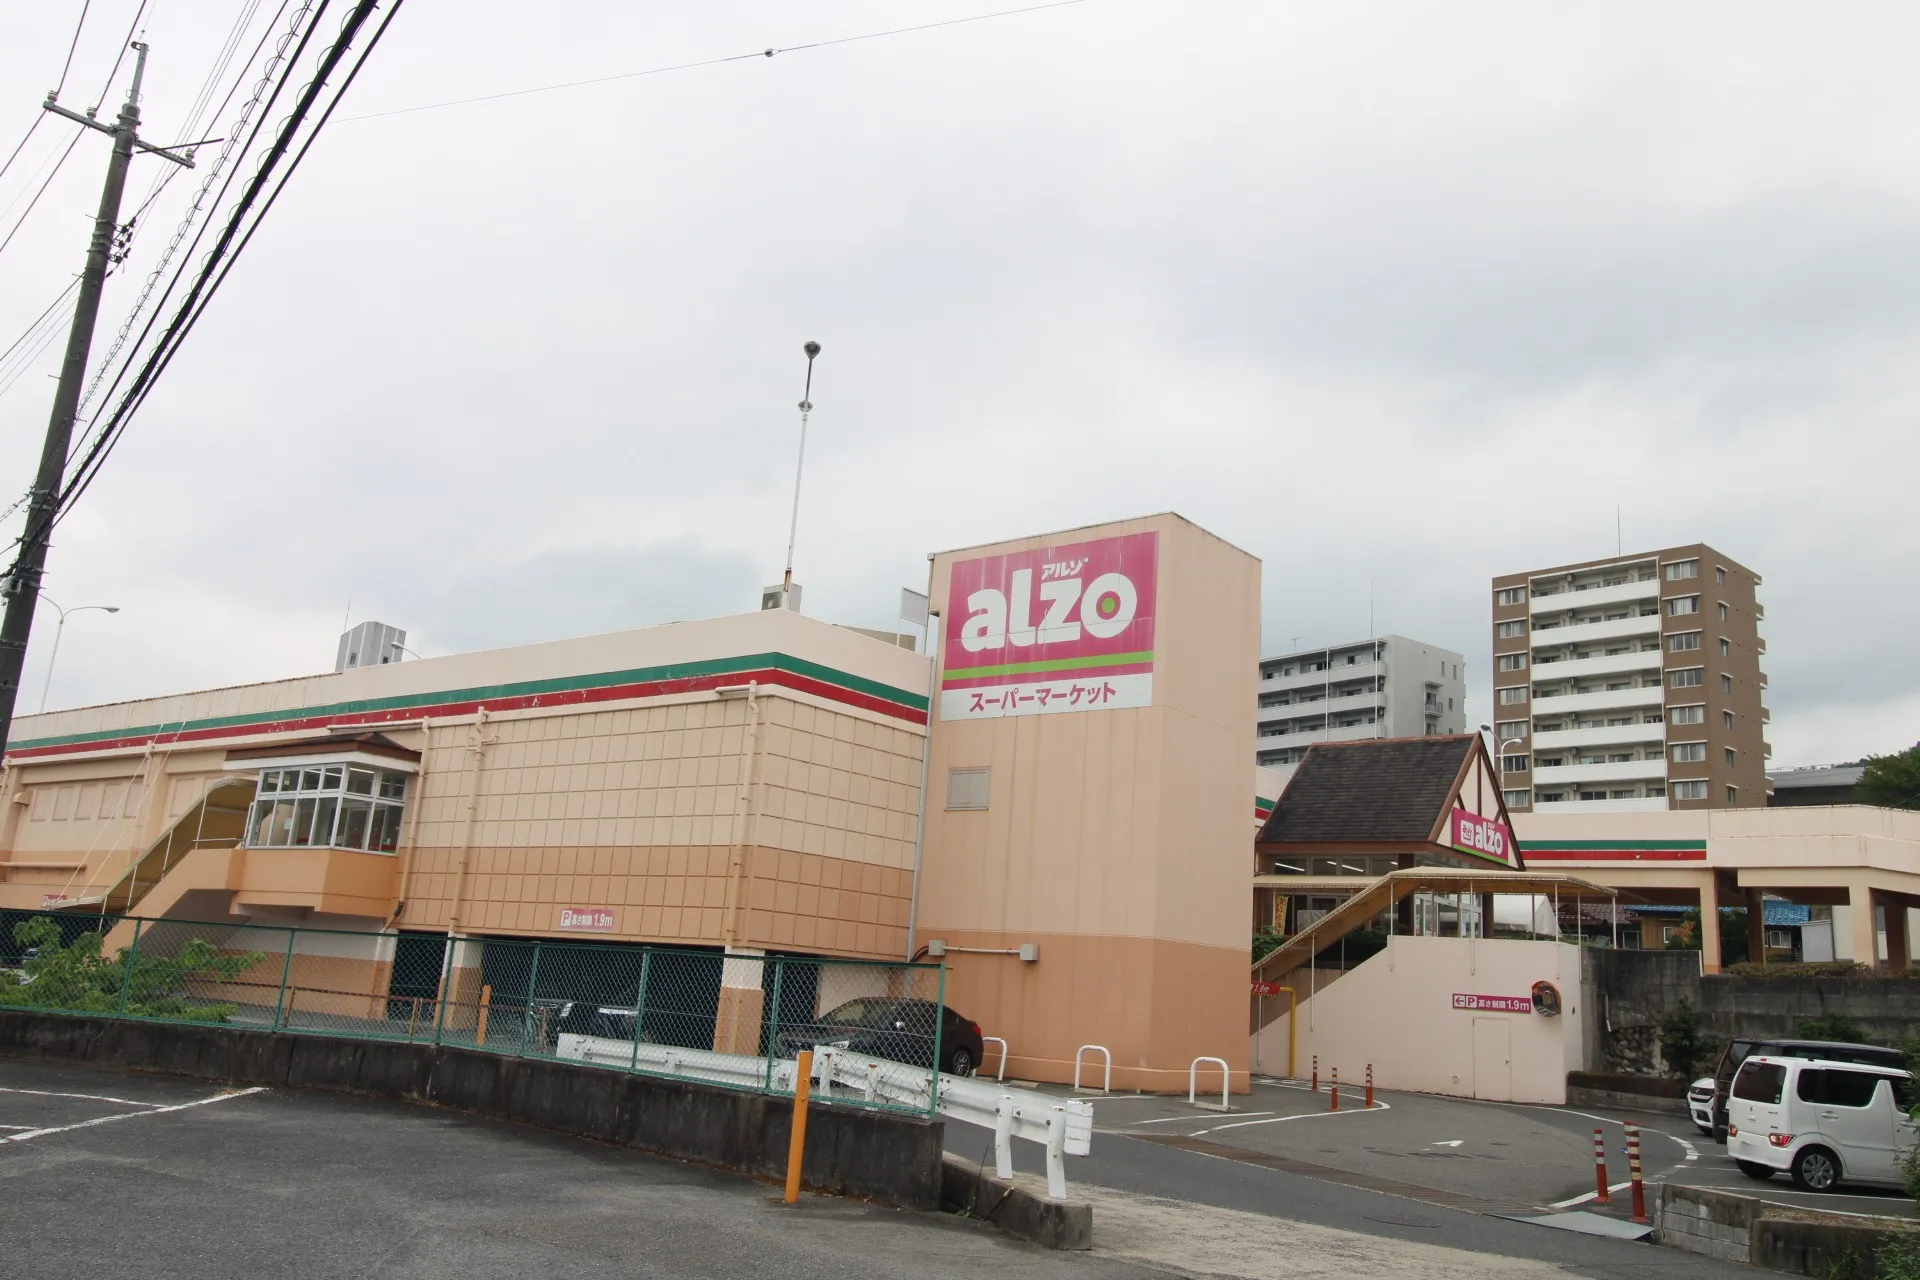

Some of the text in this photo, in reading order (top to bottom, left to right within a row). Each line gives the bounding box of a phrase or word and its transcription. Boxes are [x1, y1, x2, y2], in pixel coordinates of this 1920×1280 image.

[1041, 557, 1089, 579] アルゾ
[961, 568, 1138, 653] alzo
[969, 682, 1117, 713] スーパーマーケット
[1475, 821, 1503, 855] alzo
[1467, 997, 1476, 1007] P
